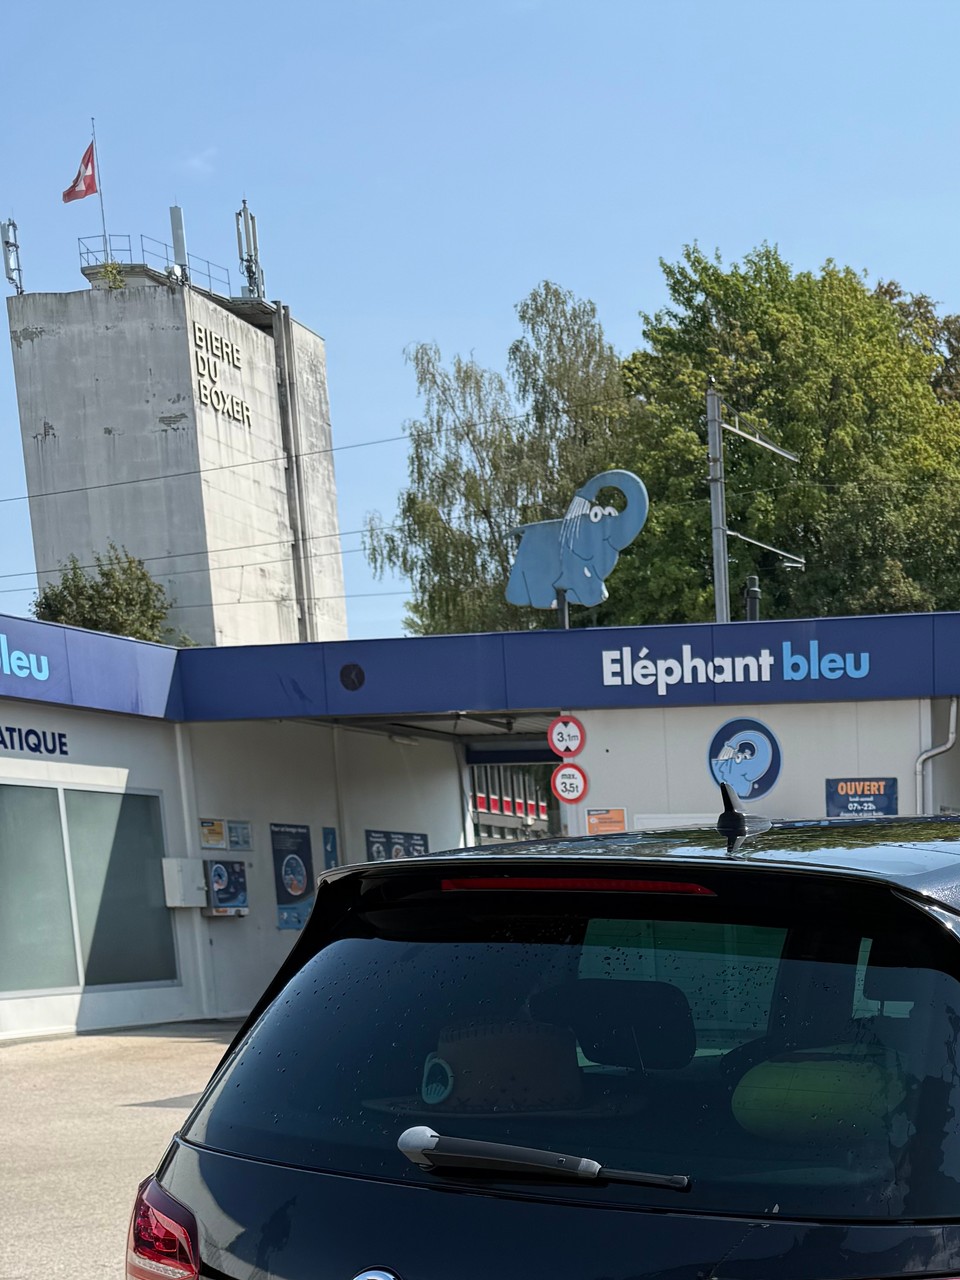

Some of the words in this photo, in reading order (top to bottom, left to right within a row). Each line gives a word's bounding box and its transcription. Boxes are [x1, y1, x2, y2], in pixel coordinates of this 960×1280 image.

[193, 320, 242, 370] BIERE
[195, 350, 219, 385] DU
[198, 379, 252, 430] BOXER
[0, 633, 49, 681] leu
[602, 644, 774, 696] Eléphant
[782, 640, 870, 681] bleu
[837, 781, 886, 796] OUVERT
